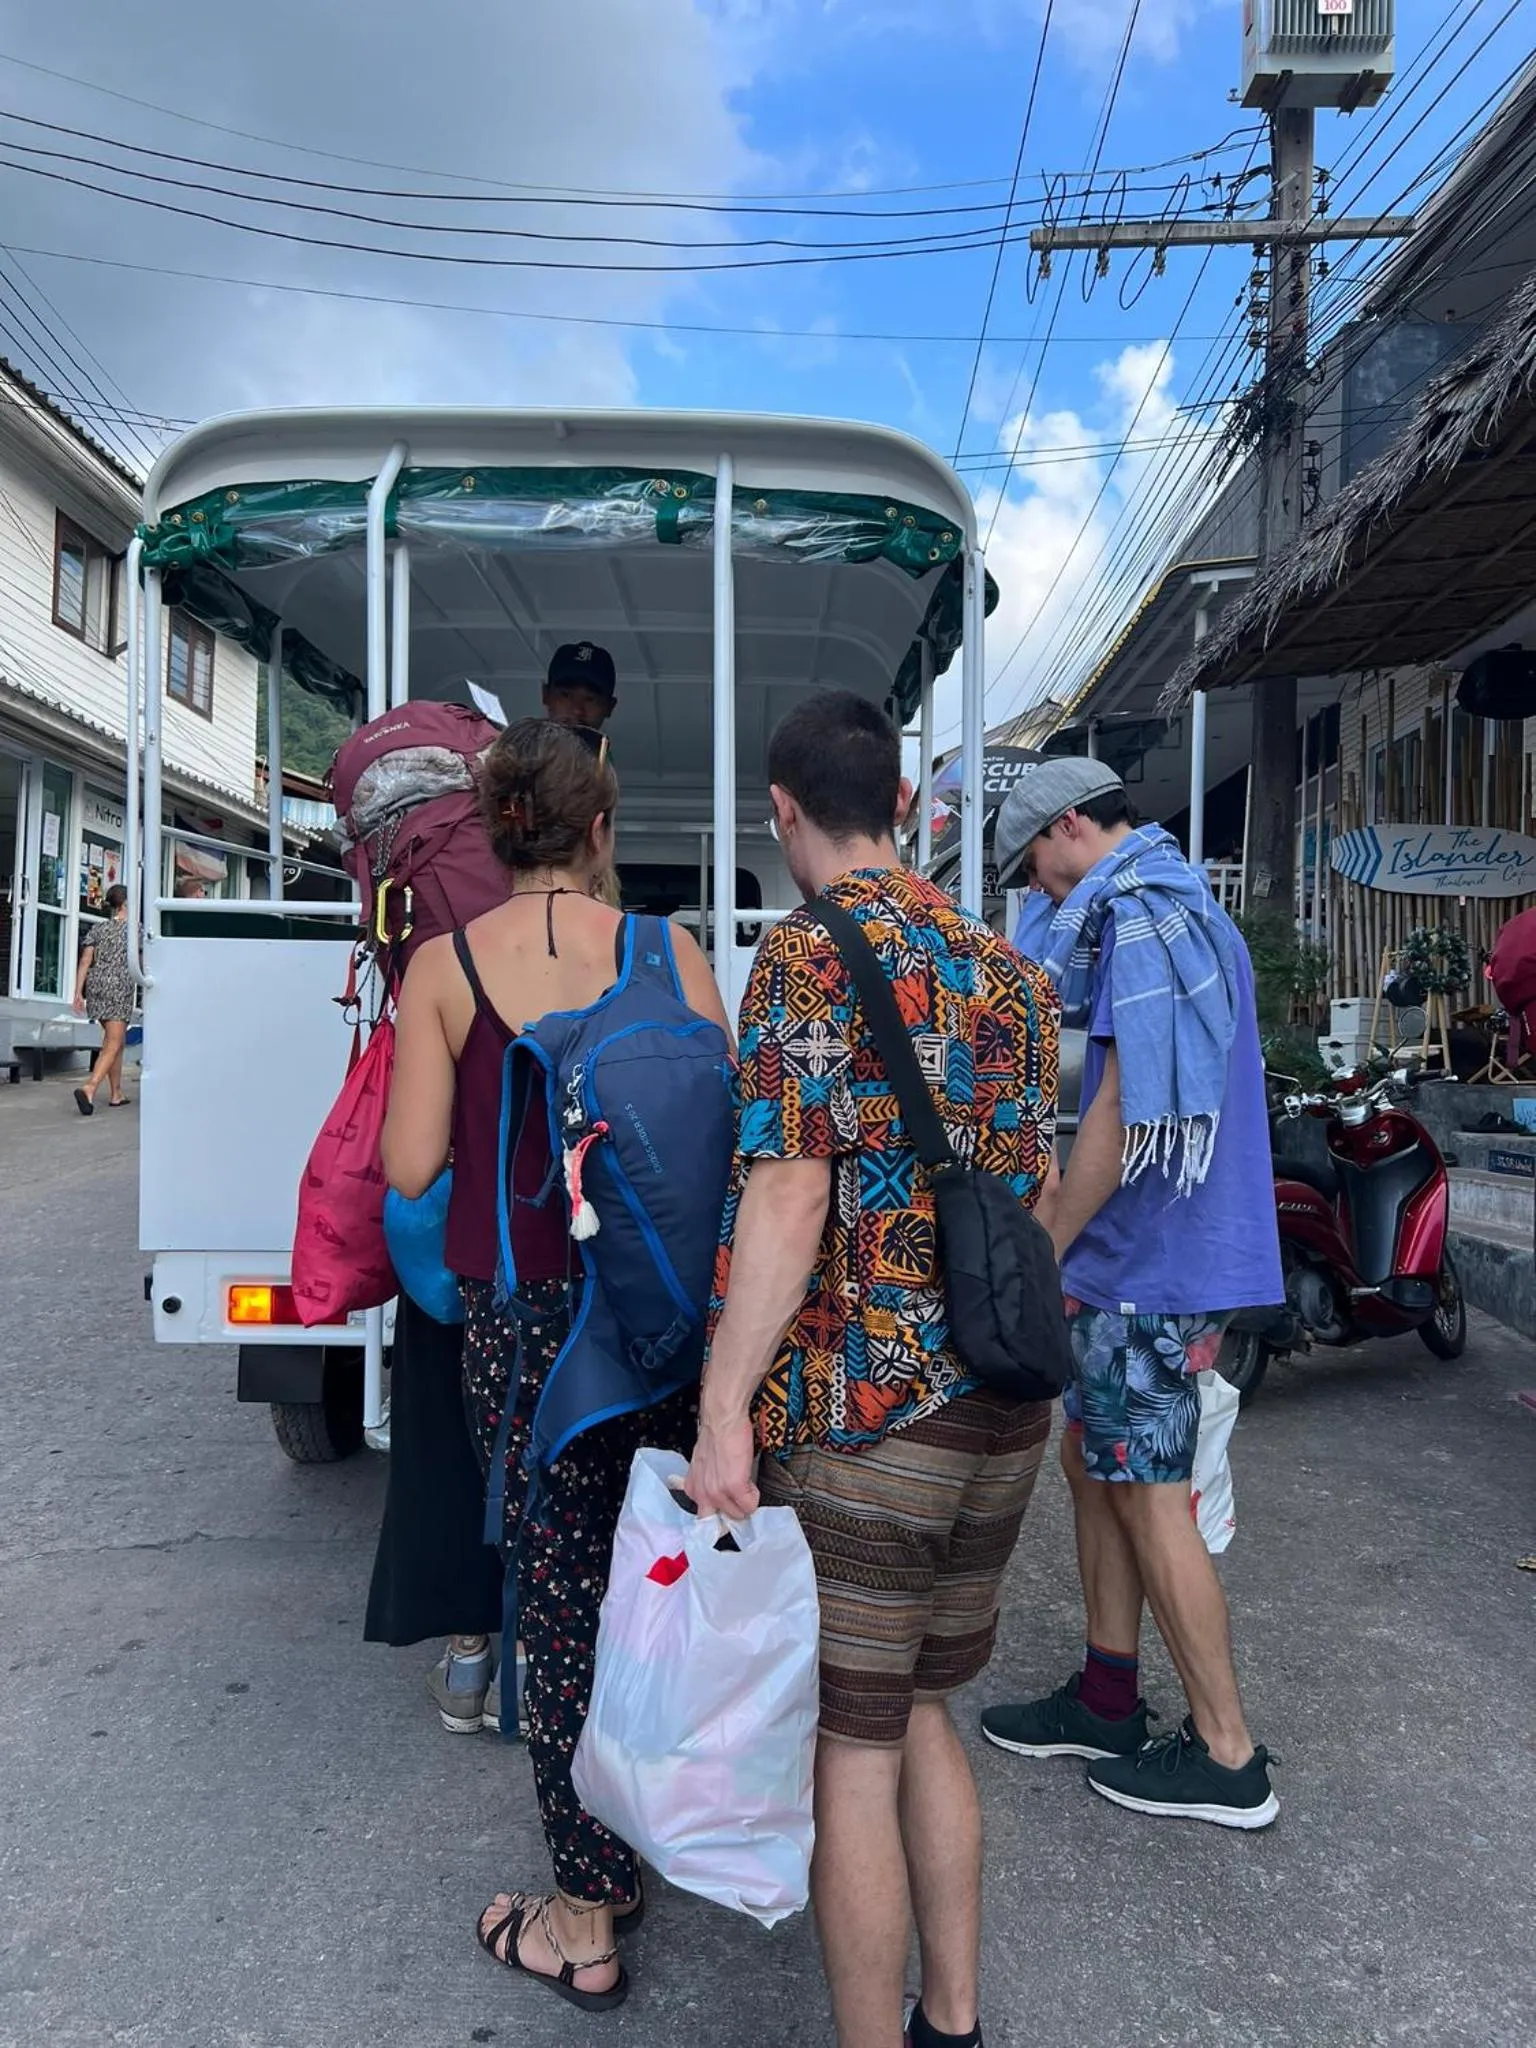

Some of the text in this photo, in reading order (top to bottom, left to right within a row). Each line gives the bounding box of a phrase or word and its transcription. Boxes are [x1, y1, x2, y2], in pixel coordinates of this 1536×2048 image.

[95, 804, 122, 828] Nitro
[1449, 828, 1484, 850] The
[1388, 833, 1534, 874] Islander
